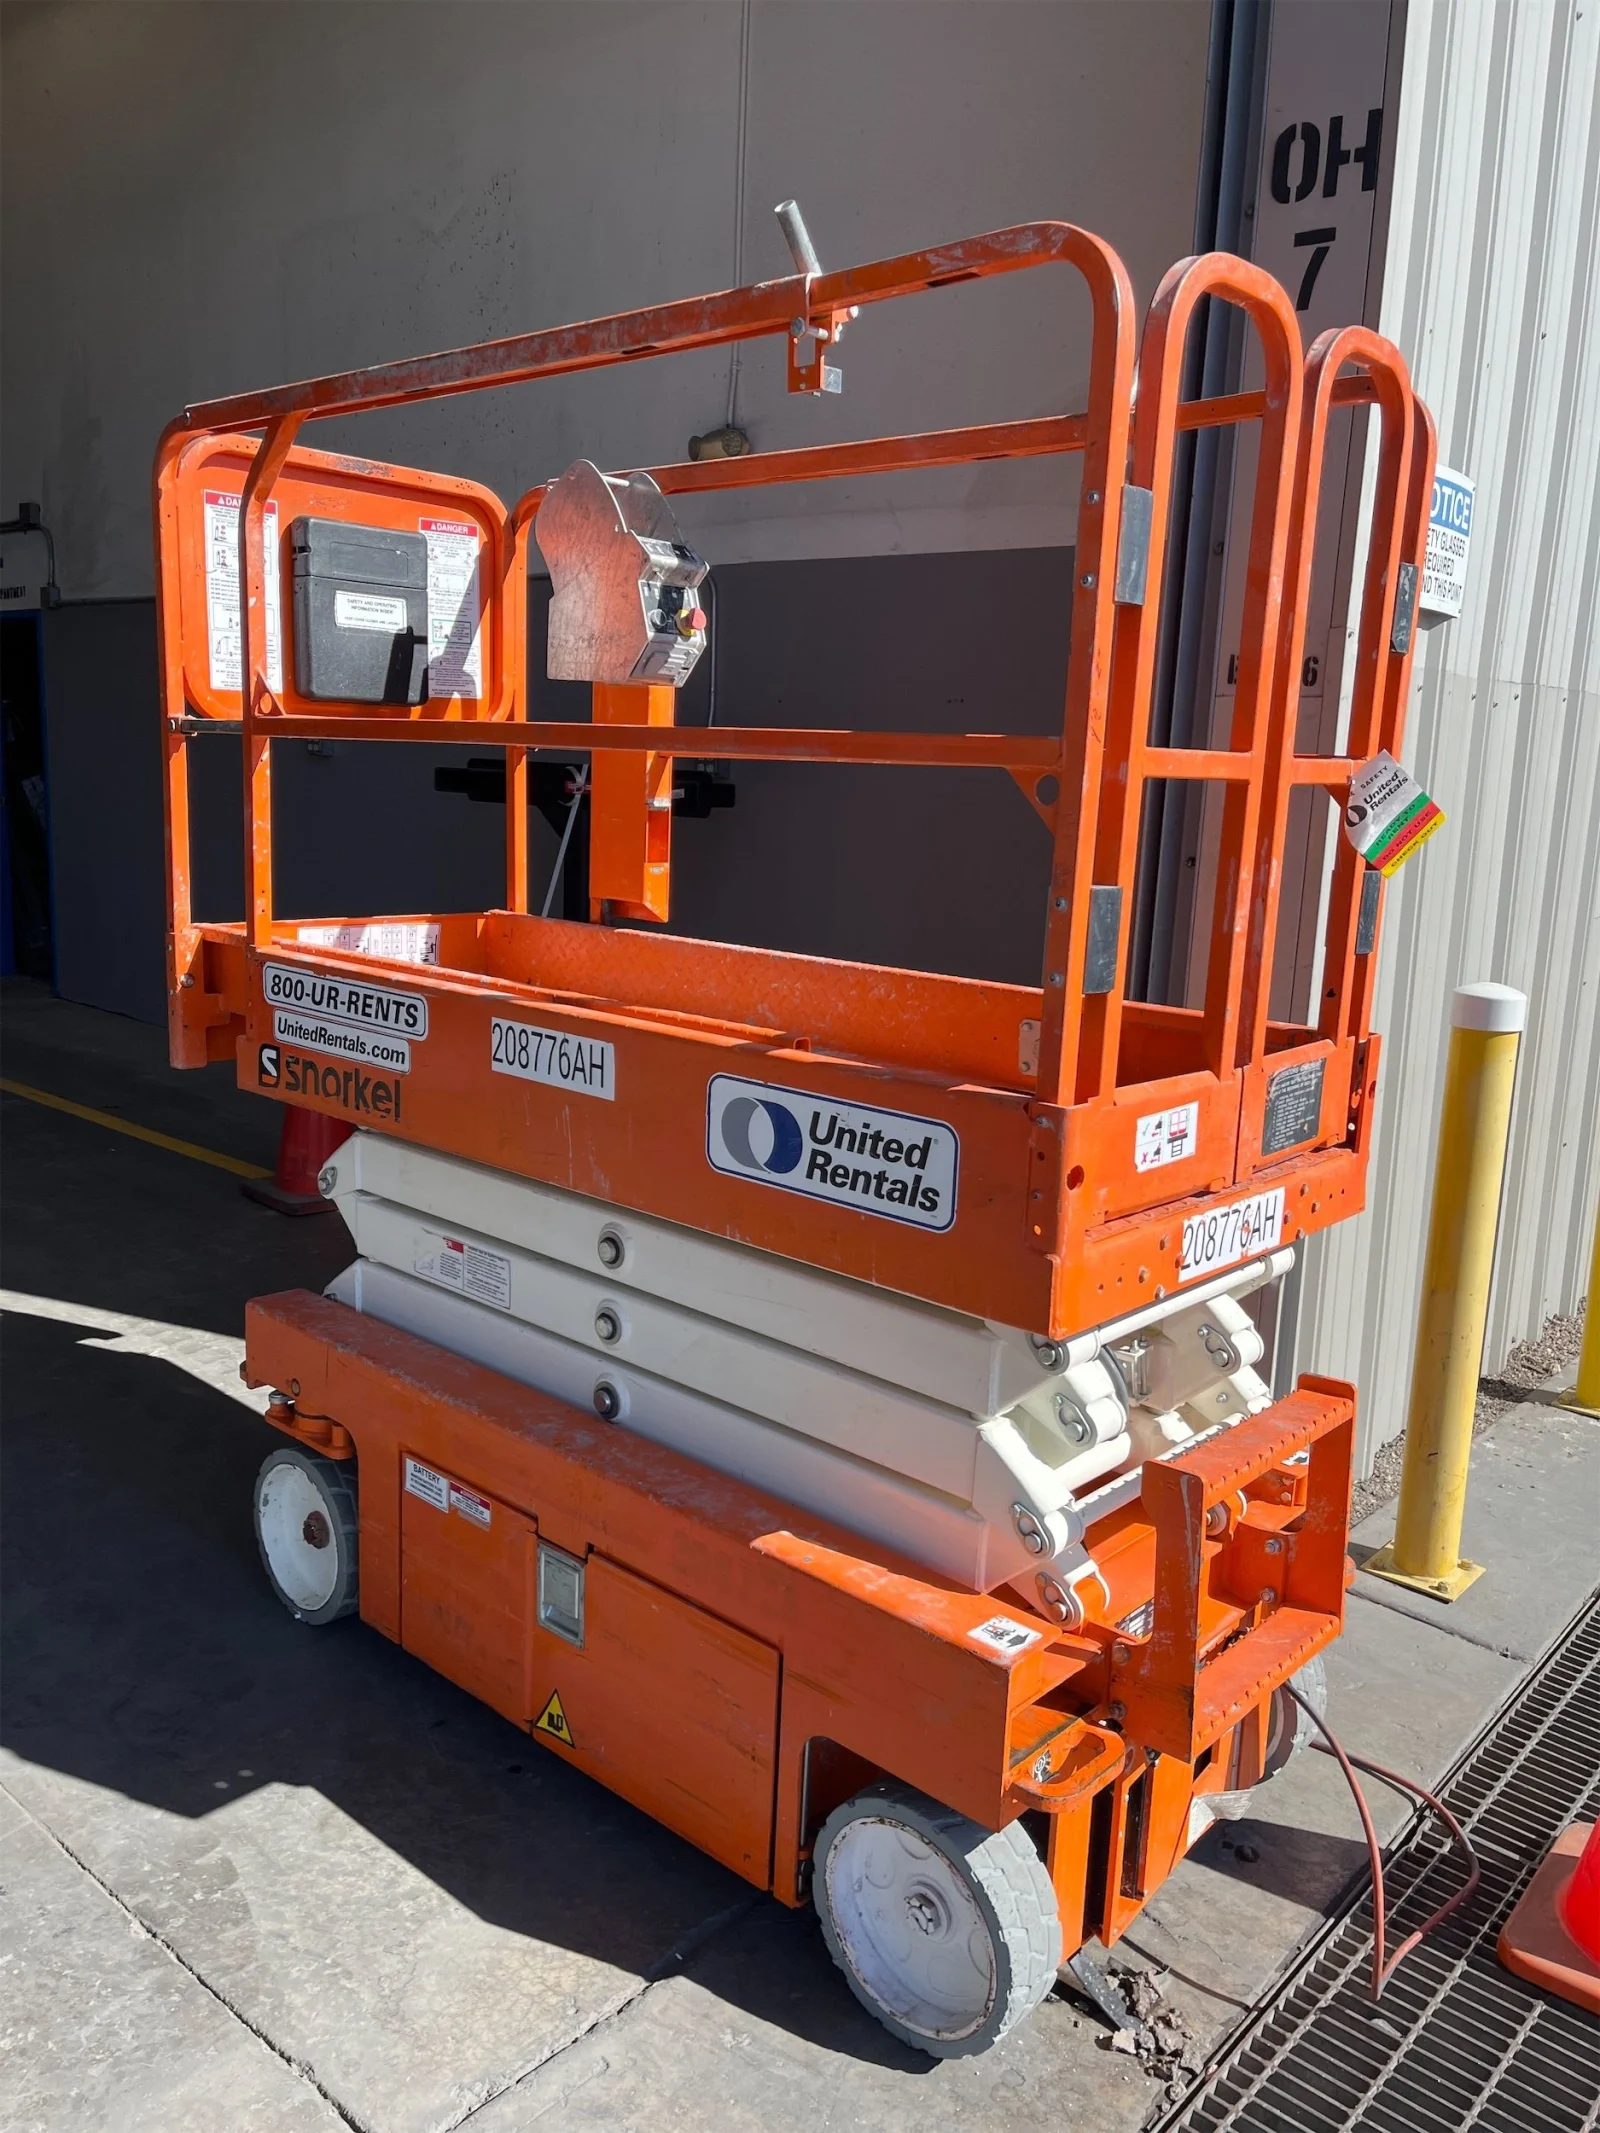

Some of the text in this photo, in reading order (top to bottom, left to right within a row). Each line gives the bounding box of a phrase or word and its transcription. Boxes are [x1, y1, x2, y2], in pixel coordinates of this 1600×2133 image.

[1271, 108, 1382, 204] OH
[1293, 227, 1337, 312] 7
[436, 522, 469, 535] DANGER
[1430, 482, 1471, 530] OTICE
[1302, 656, 1319, 687] 6
[1360, 765, 1388, 789] SAFETY
[1363, 771, 1400, 805] United
[1369, 776, 1409, 812] Rentals
[1382, 811, 1431, 861] DO NOT USE
[1390, 821, 1438, 867] CHECK OUT
[270, 973, 419, 1029] 800-UR-RENTS
[277, 1015, 406, 1065] UnitedRentals.com
[492, 1022, 605, 1089] 208776AH
[808, 1110, 933, 1171] United
[805, 1148, 940, 1213] Rentals
[1180, 1195, 1278, 1271] 208776AH
[413, 1463, 440, 1485] BATTERY
